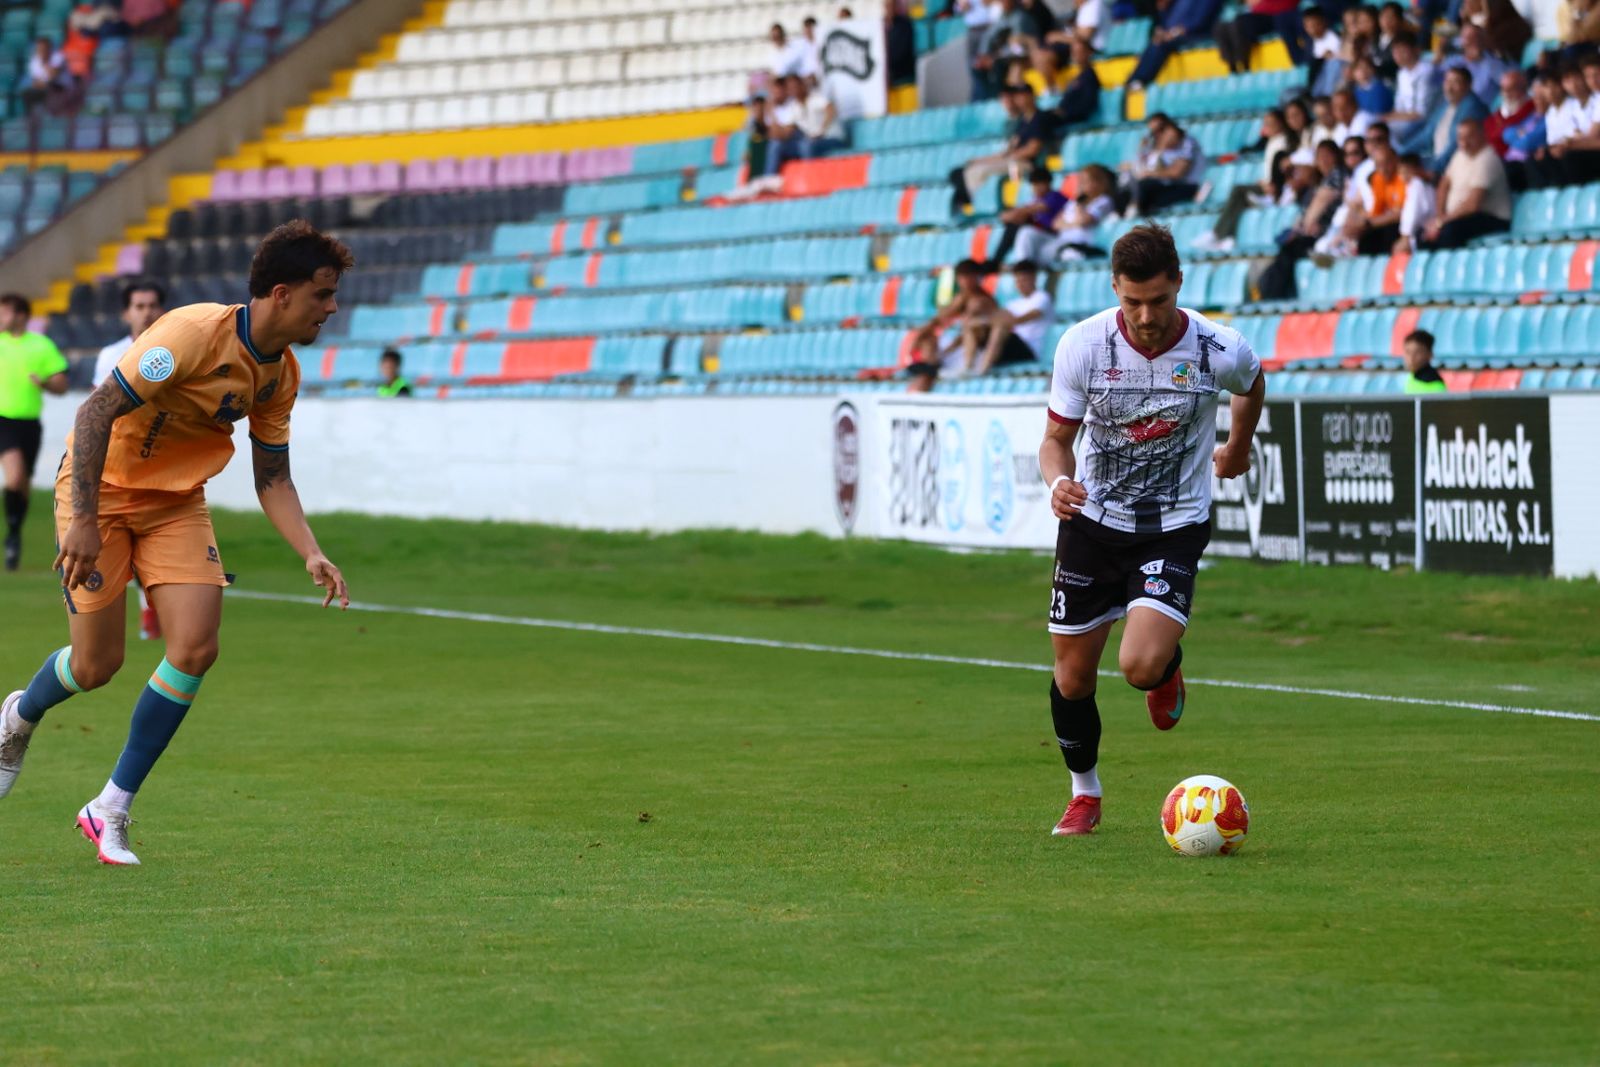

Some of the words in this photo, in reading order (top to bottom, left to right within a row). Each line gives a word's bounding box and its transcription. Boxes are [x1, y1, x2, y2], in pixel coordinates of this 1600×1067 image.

[1323, 450, 1394, 479] EMPRESARIAL
[1424, 423, 1535, 489] Autolack
[1424, 499, 1513, 553] PINTURAS,
[1517, 500, 1550, 546] S.L.
[1050, 587, 1066, 620] 23
